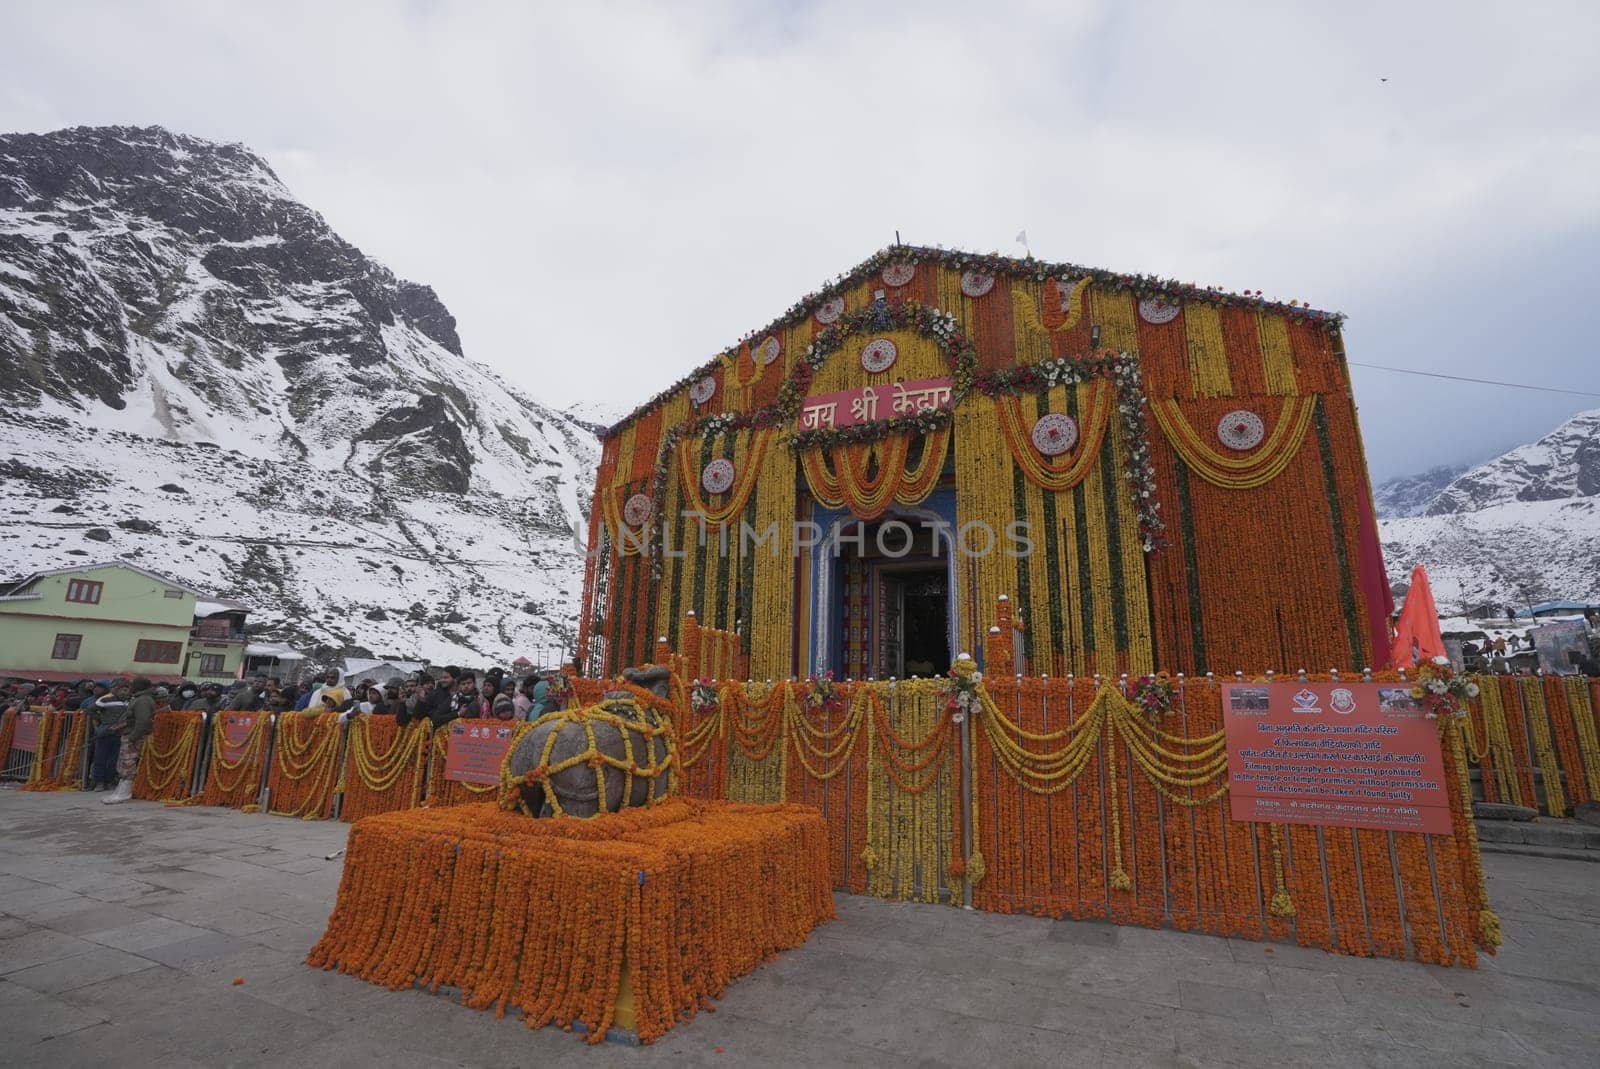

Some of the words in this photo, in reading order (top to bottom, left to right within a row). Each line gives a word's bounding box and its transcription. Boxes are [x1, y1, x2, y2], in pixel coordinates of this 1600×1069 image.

[803, 402, 837, 430] जय
[850, 387, 879, 421] श्री
[892, 383, 952, 416] केदार
[1350, 767, 1377, 776] strictly
[1380, 768, 1421, 777] prohibited
[1256, 774, 1280, 782] temple
[1293, 775, 1318, 783] temple
[1320, 777, 1356, 786] premises
[1359, 778, 1389, 786] without
[1279, 785, 1303, 793] Action
[1332, 787, 1353, 795] taken
[1363, 789, 1386, 797] found
